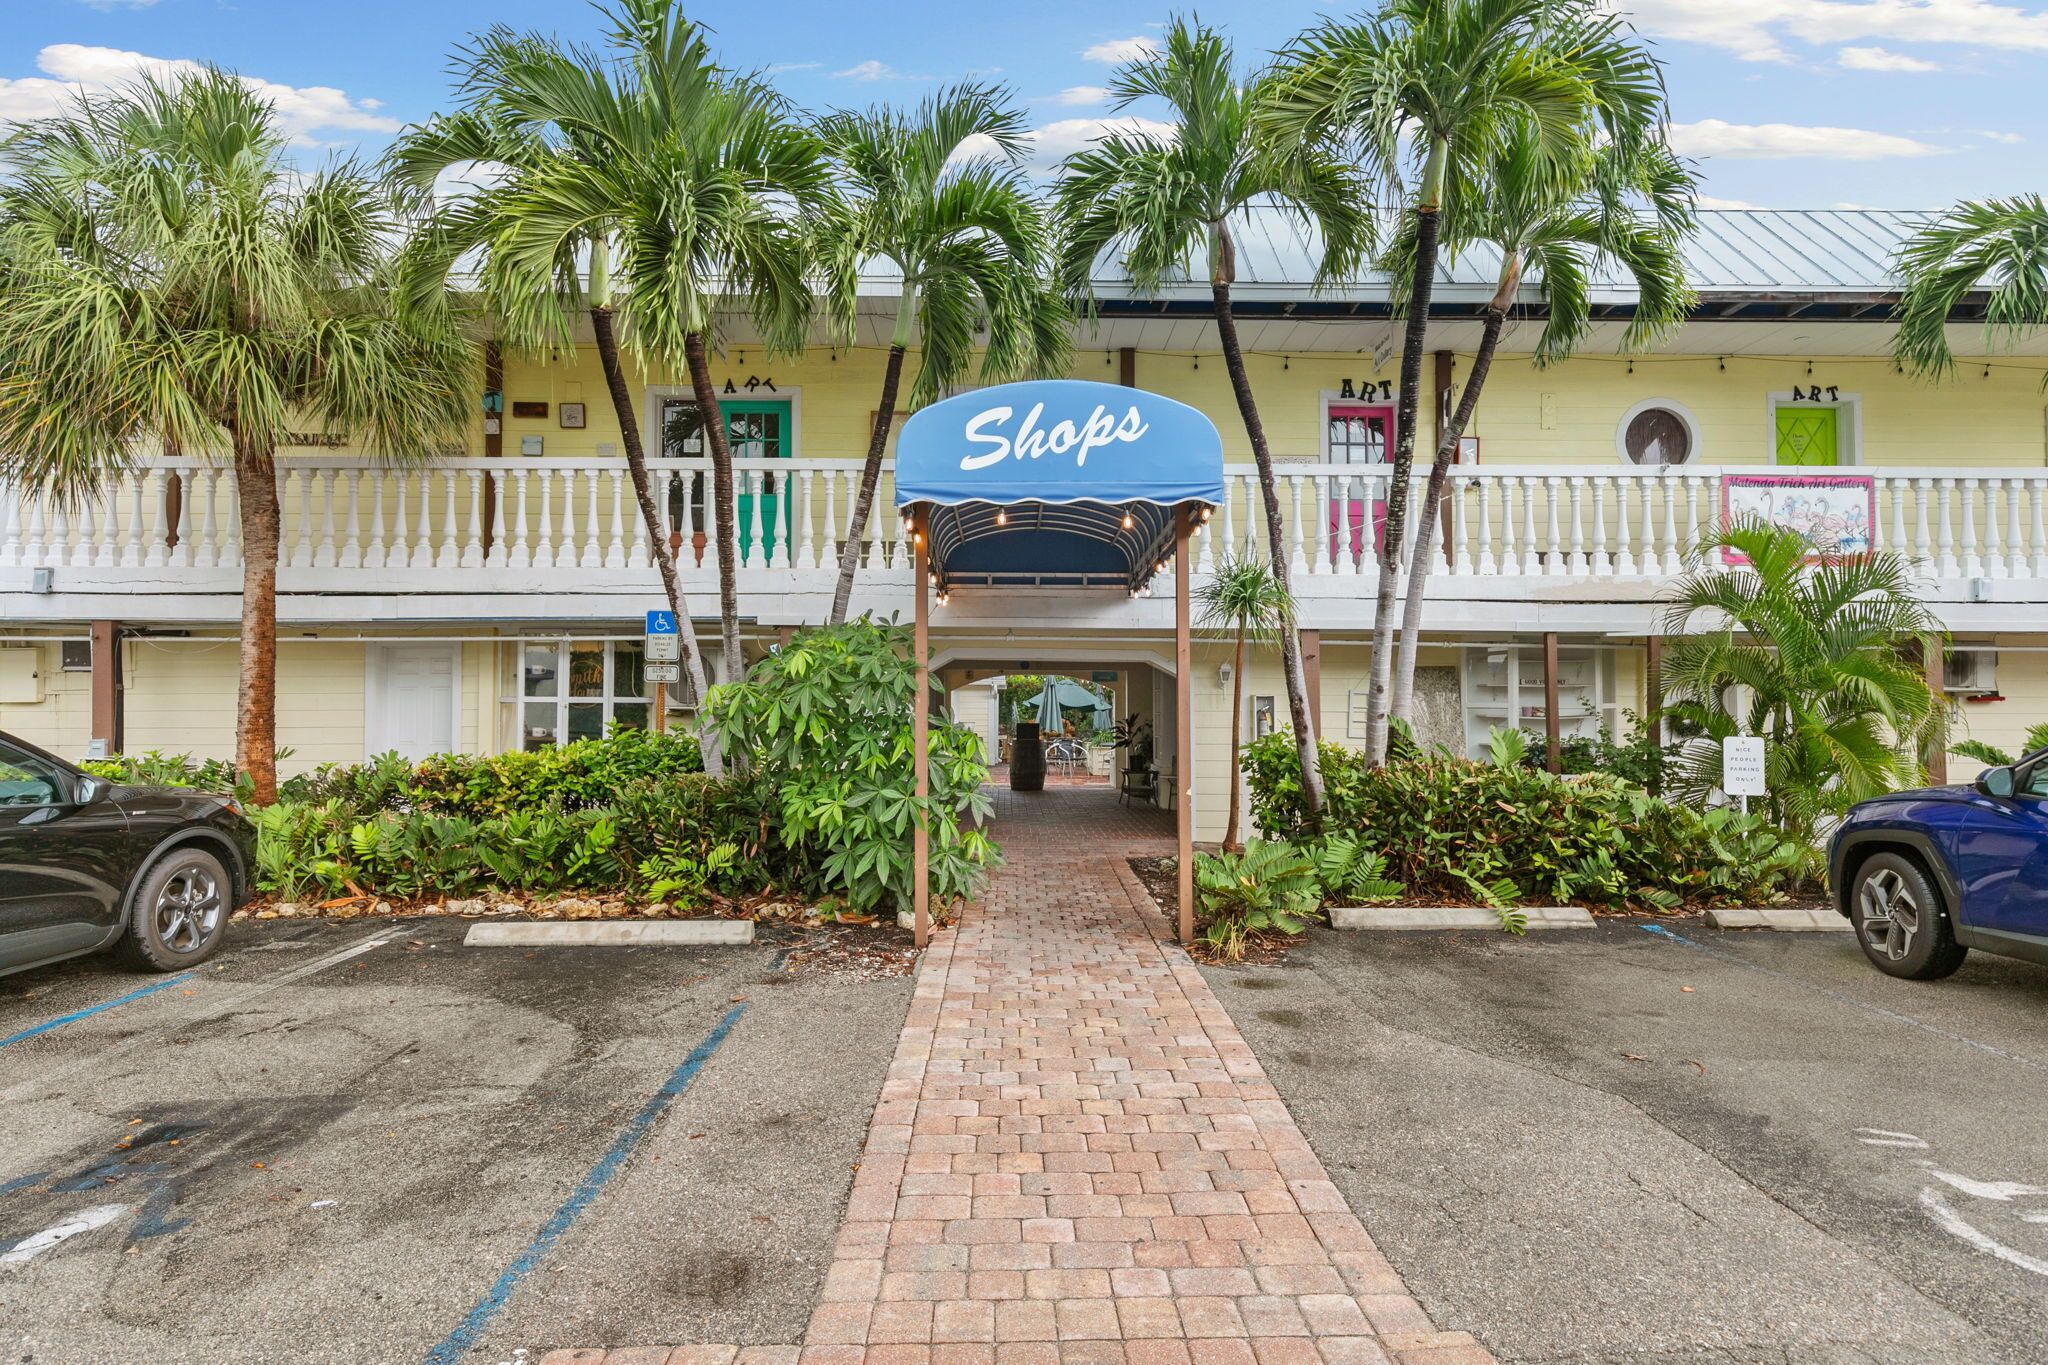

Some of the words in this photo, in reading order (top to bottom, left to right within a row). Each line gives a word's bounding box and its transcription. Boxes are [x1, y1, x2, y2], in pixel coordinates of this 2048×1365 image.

[723, 375, 777, 394] ART
[1340, 378, 1392, 404] ART
[1792, 385, 1839, 403] ART
[960, 402, 1150, 471] Shops
[1829, 477, 1870, 492] Gallery
